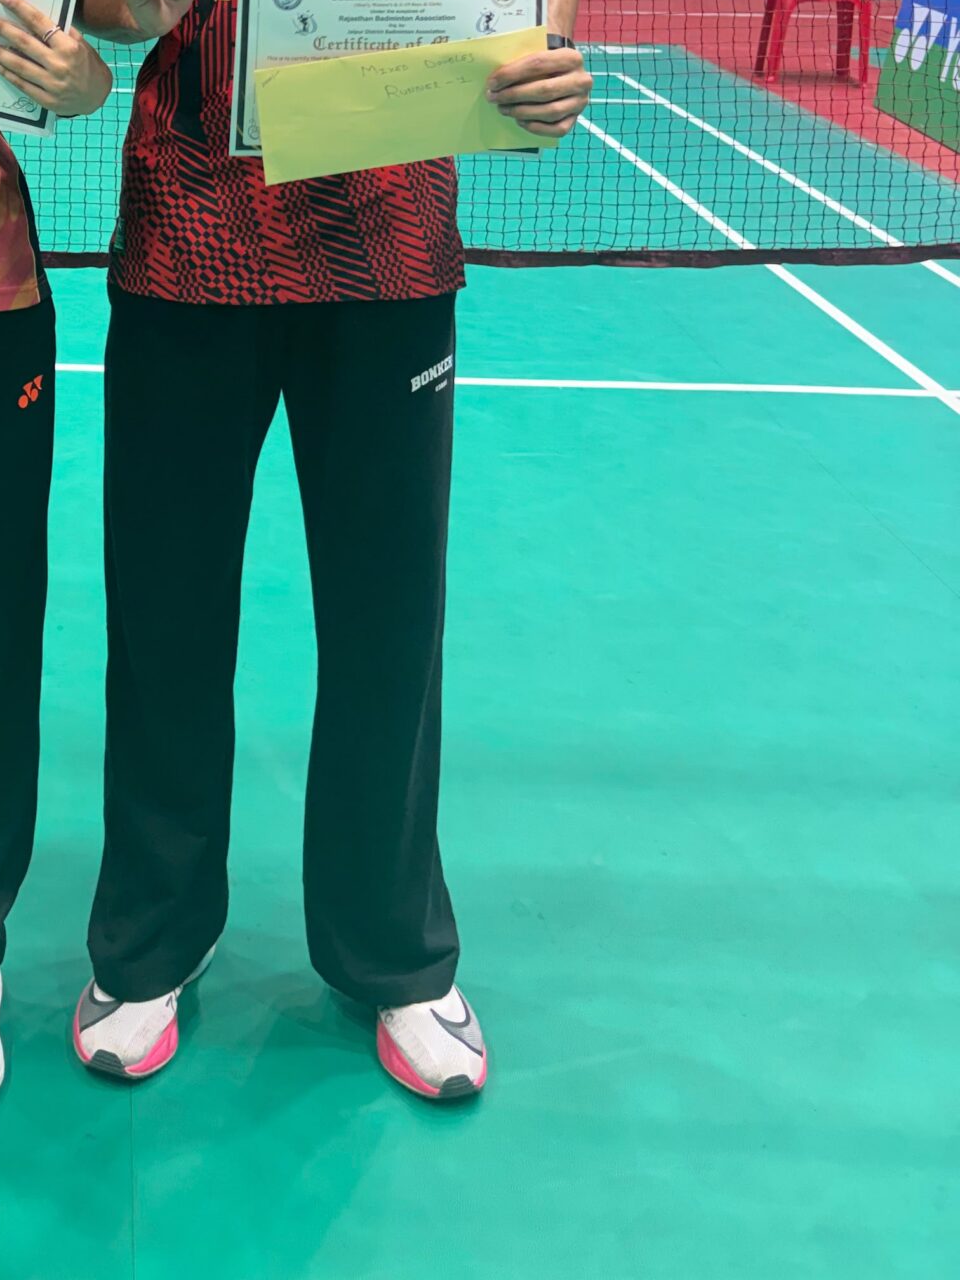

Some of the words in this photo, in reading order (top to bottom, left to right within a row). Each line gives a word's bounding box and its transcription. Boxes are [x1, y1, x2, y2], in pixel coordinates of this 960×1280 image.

[338, 15, 373, 23] Rajasthan
[415, 14, 456, 22] Association
[313, 36, 400, 51] Certificate
